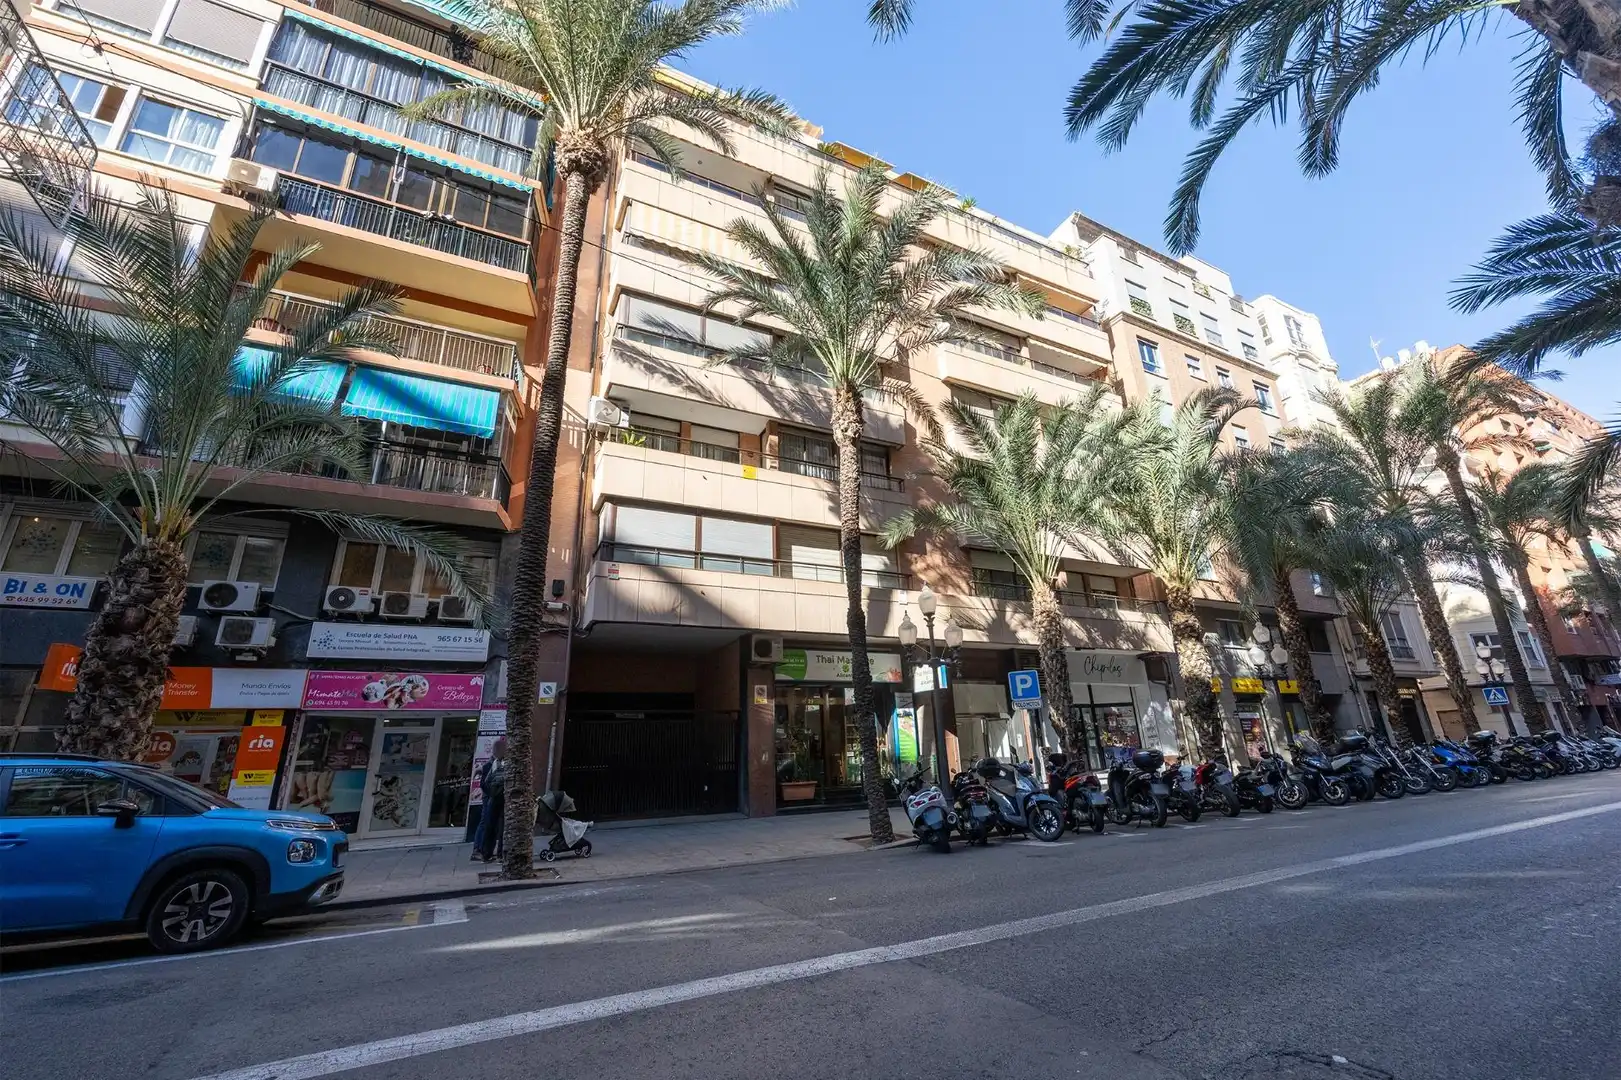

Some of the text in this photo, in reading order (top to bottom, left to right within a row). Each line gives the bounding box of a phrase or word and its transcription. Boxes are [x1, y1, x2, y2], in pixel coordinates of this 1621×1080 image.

[4, 578, 88, 598] BI & ON
[815, 655, 835, 664] Thai
[168, 681, 197, 690] Money
[1015, 675, 1033, 697] P
[443, 690, 474, 703] Belleza
[248, 734, 274, 749] ria
